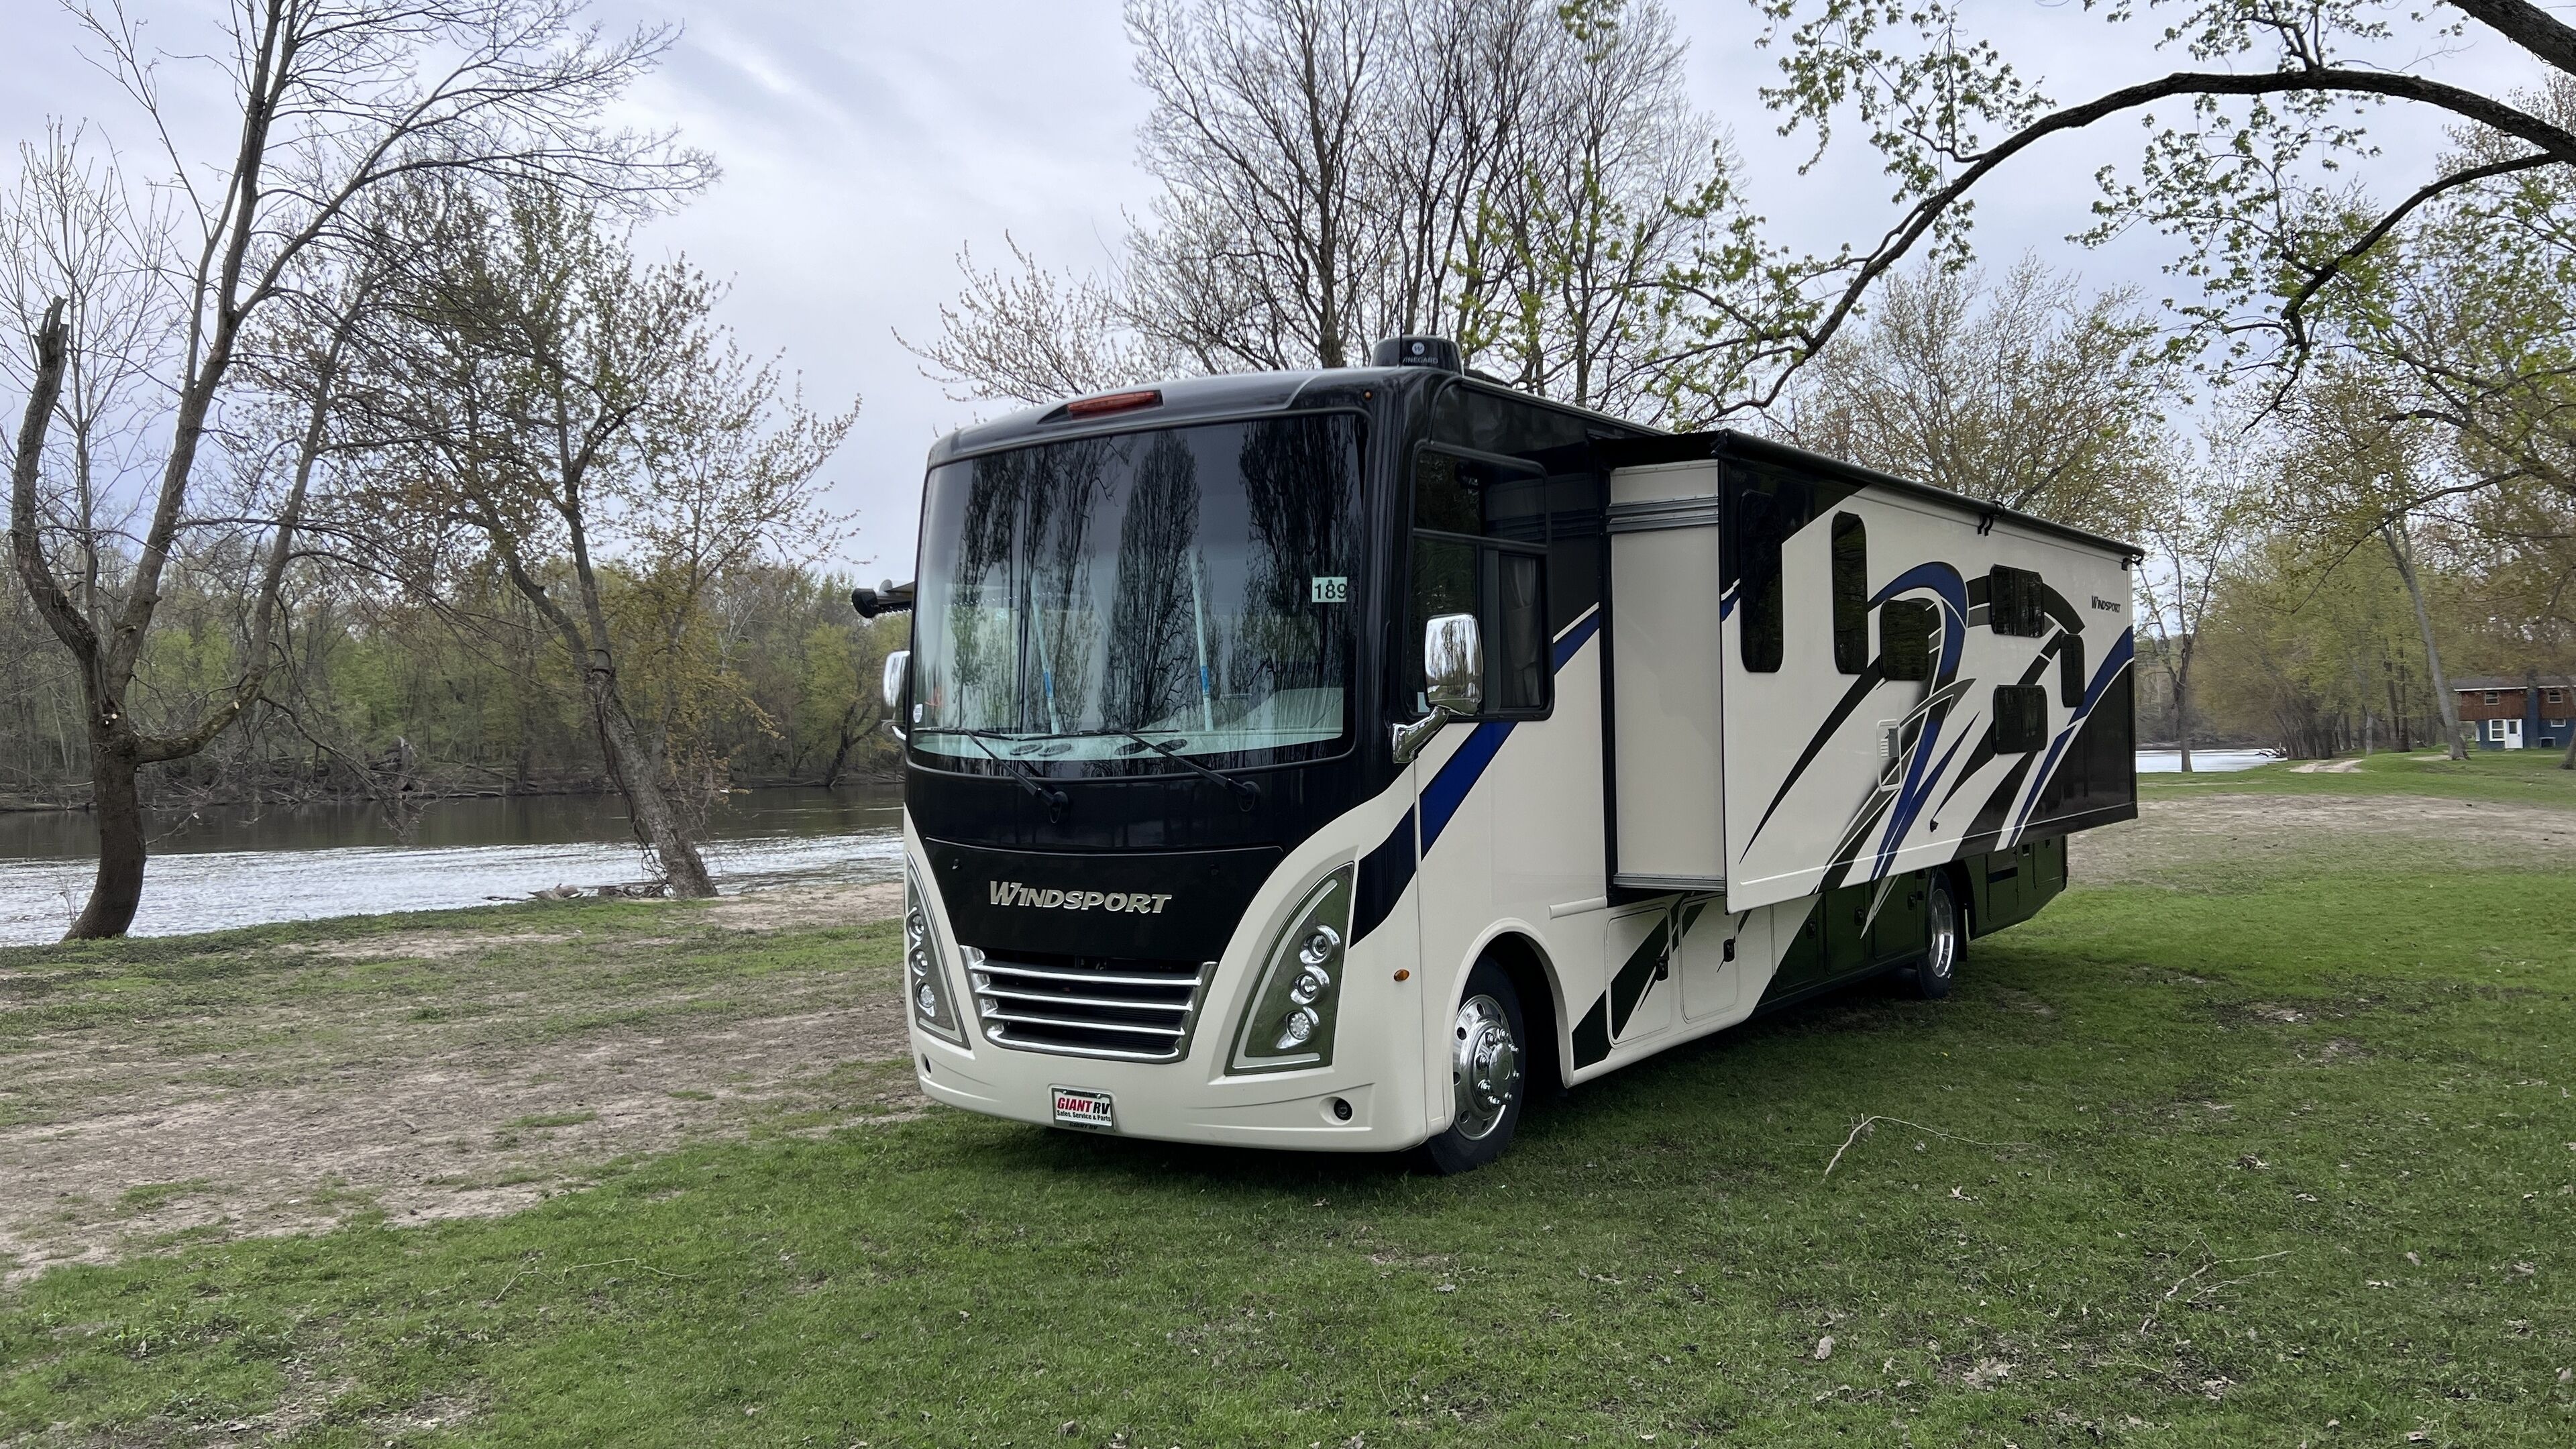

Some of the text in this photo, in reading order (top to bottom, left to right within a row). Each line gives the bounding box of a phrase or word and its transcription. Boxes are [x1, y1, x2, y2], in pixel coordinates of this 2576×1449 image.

[1315, 584, 1347, 599] 189
[2091, 595, 2121, 613] WINDSPORT
[990, 880, 1173, 914] WINDSPORT
[1057, 1097, 1111, 1115] GIANT RV
[1073, 1112, 1092, 1120] Service
[1097, 1114, 1112, 1122] Parts
